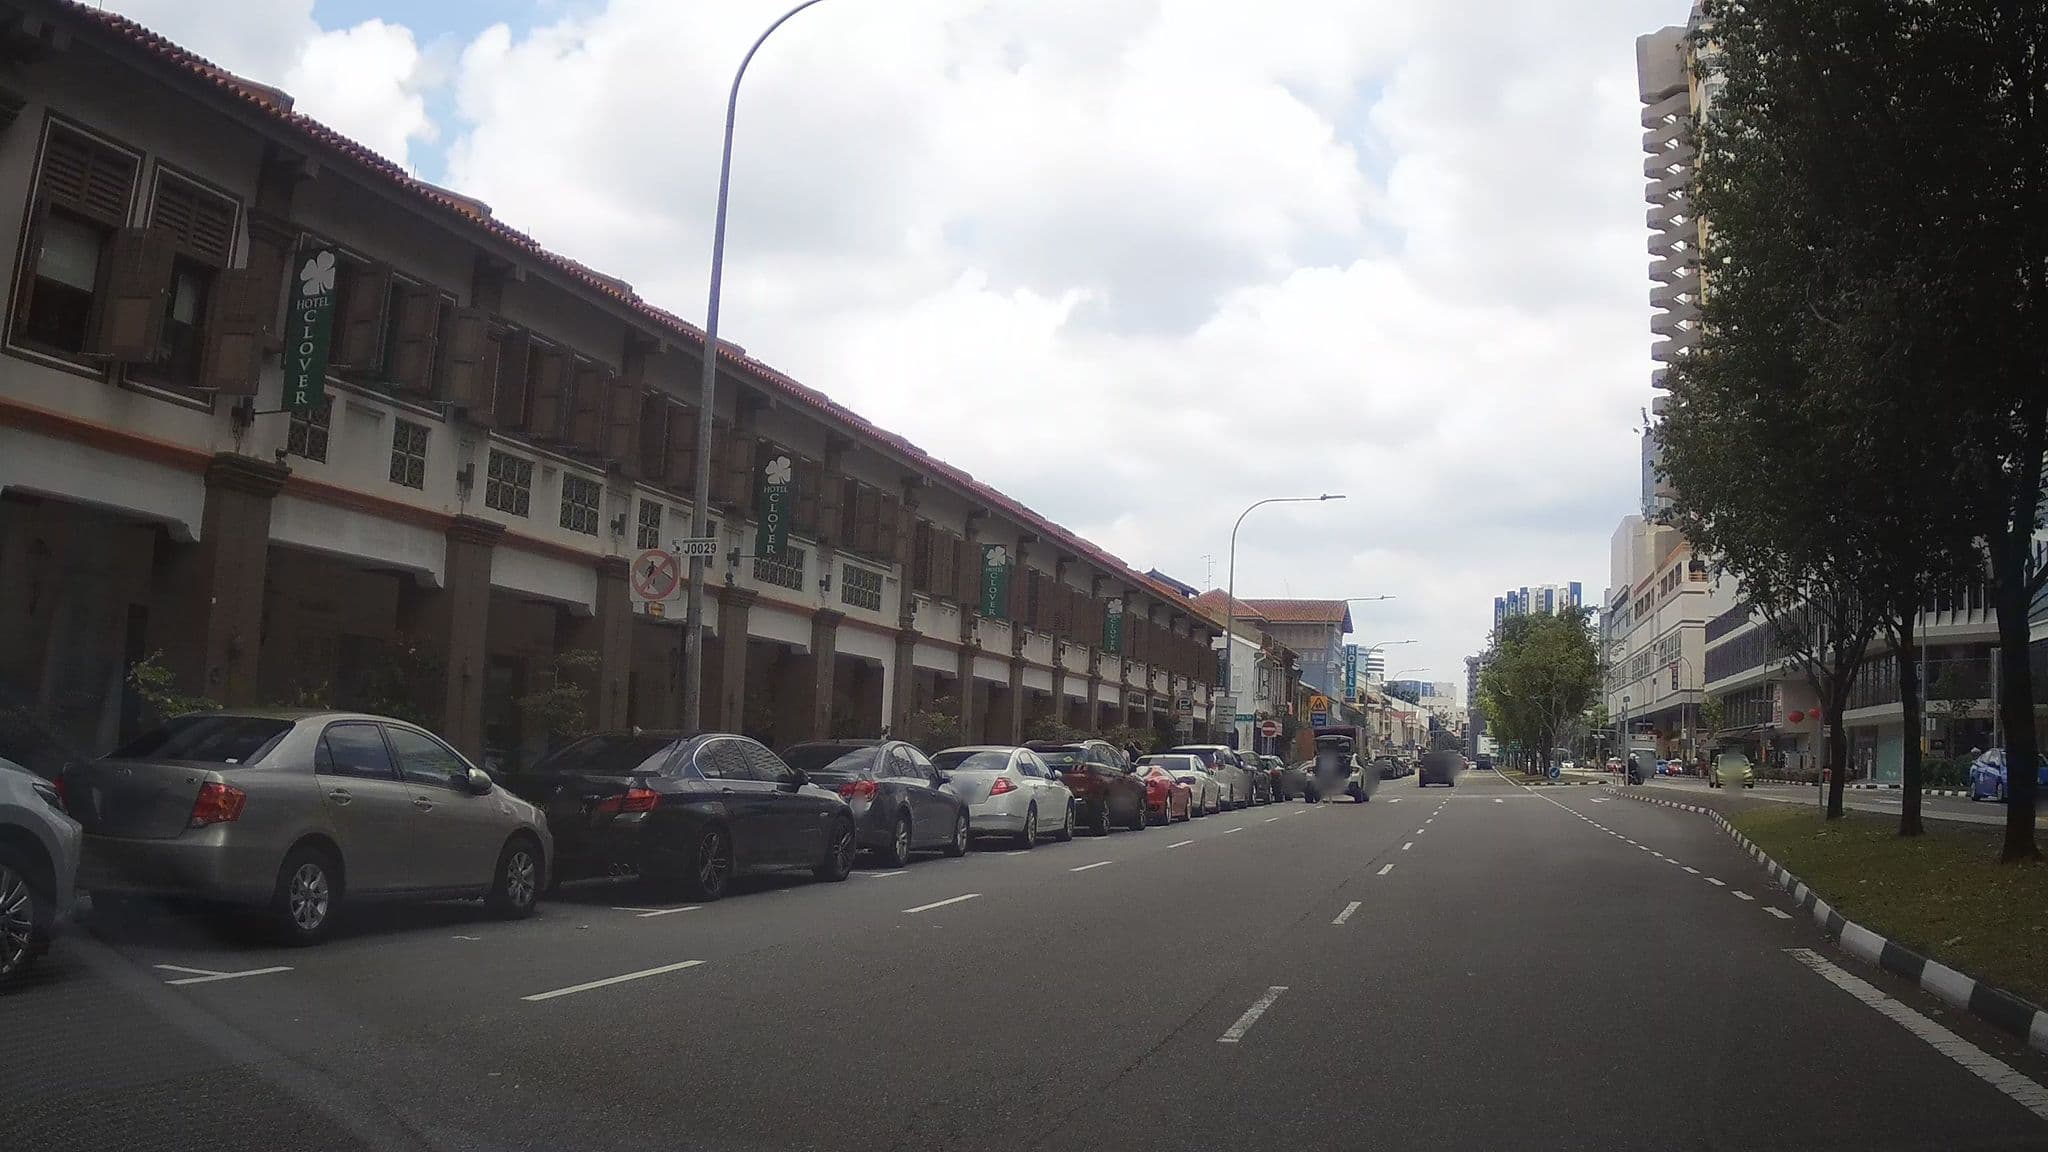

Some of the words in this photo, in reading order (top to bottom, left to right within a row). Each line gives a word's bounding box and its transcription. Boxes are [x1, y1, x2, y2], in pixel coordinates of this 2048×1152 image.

[296, 297, 329, 310] HOTEL
[294, 309, 317, 404] CLOVER
[766, 493, 779, 554] CLOVER
[684, 543, 717, 555] J0029
[988, 572, 998, 616] CLOVER
